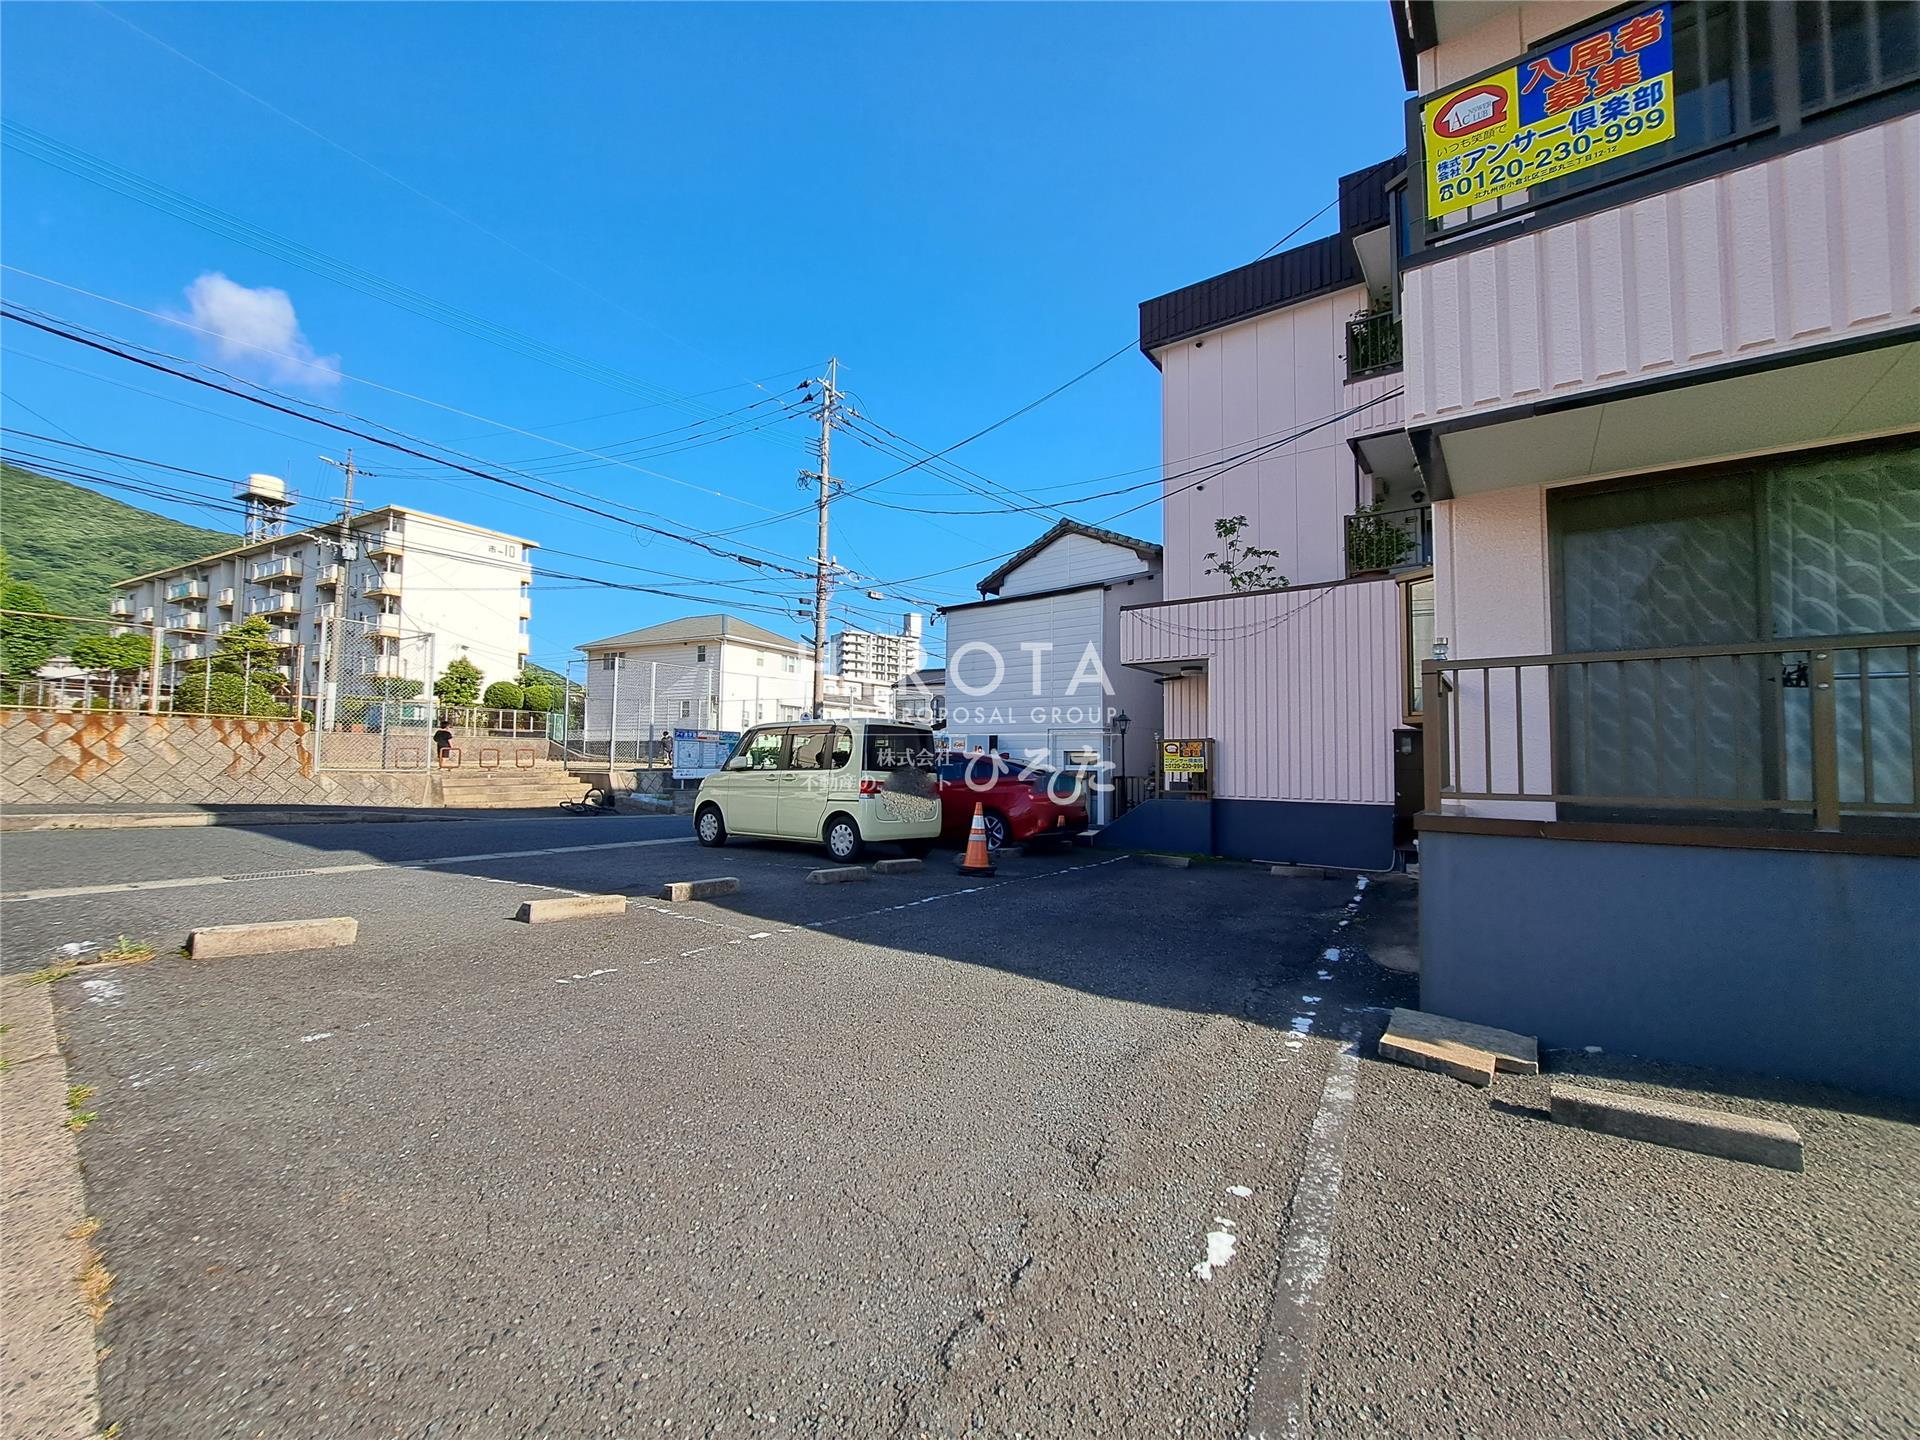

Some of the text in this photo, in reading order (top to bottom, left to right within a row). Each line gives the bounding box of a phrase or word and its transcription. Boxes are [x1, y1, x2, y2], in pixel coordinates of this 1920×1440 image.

[1522, 10, 1664, 95] 入居者
[1544, 53, 1641, 115] 募集
[1437, 123, 1507, 157] いつも笑顔で
[1456, 108, 1665, 195] 0120-230-999
[1462, 80, 1665, 173] アンサー倶楽部
